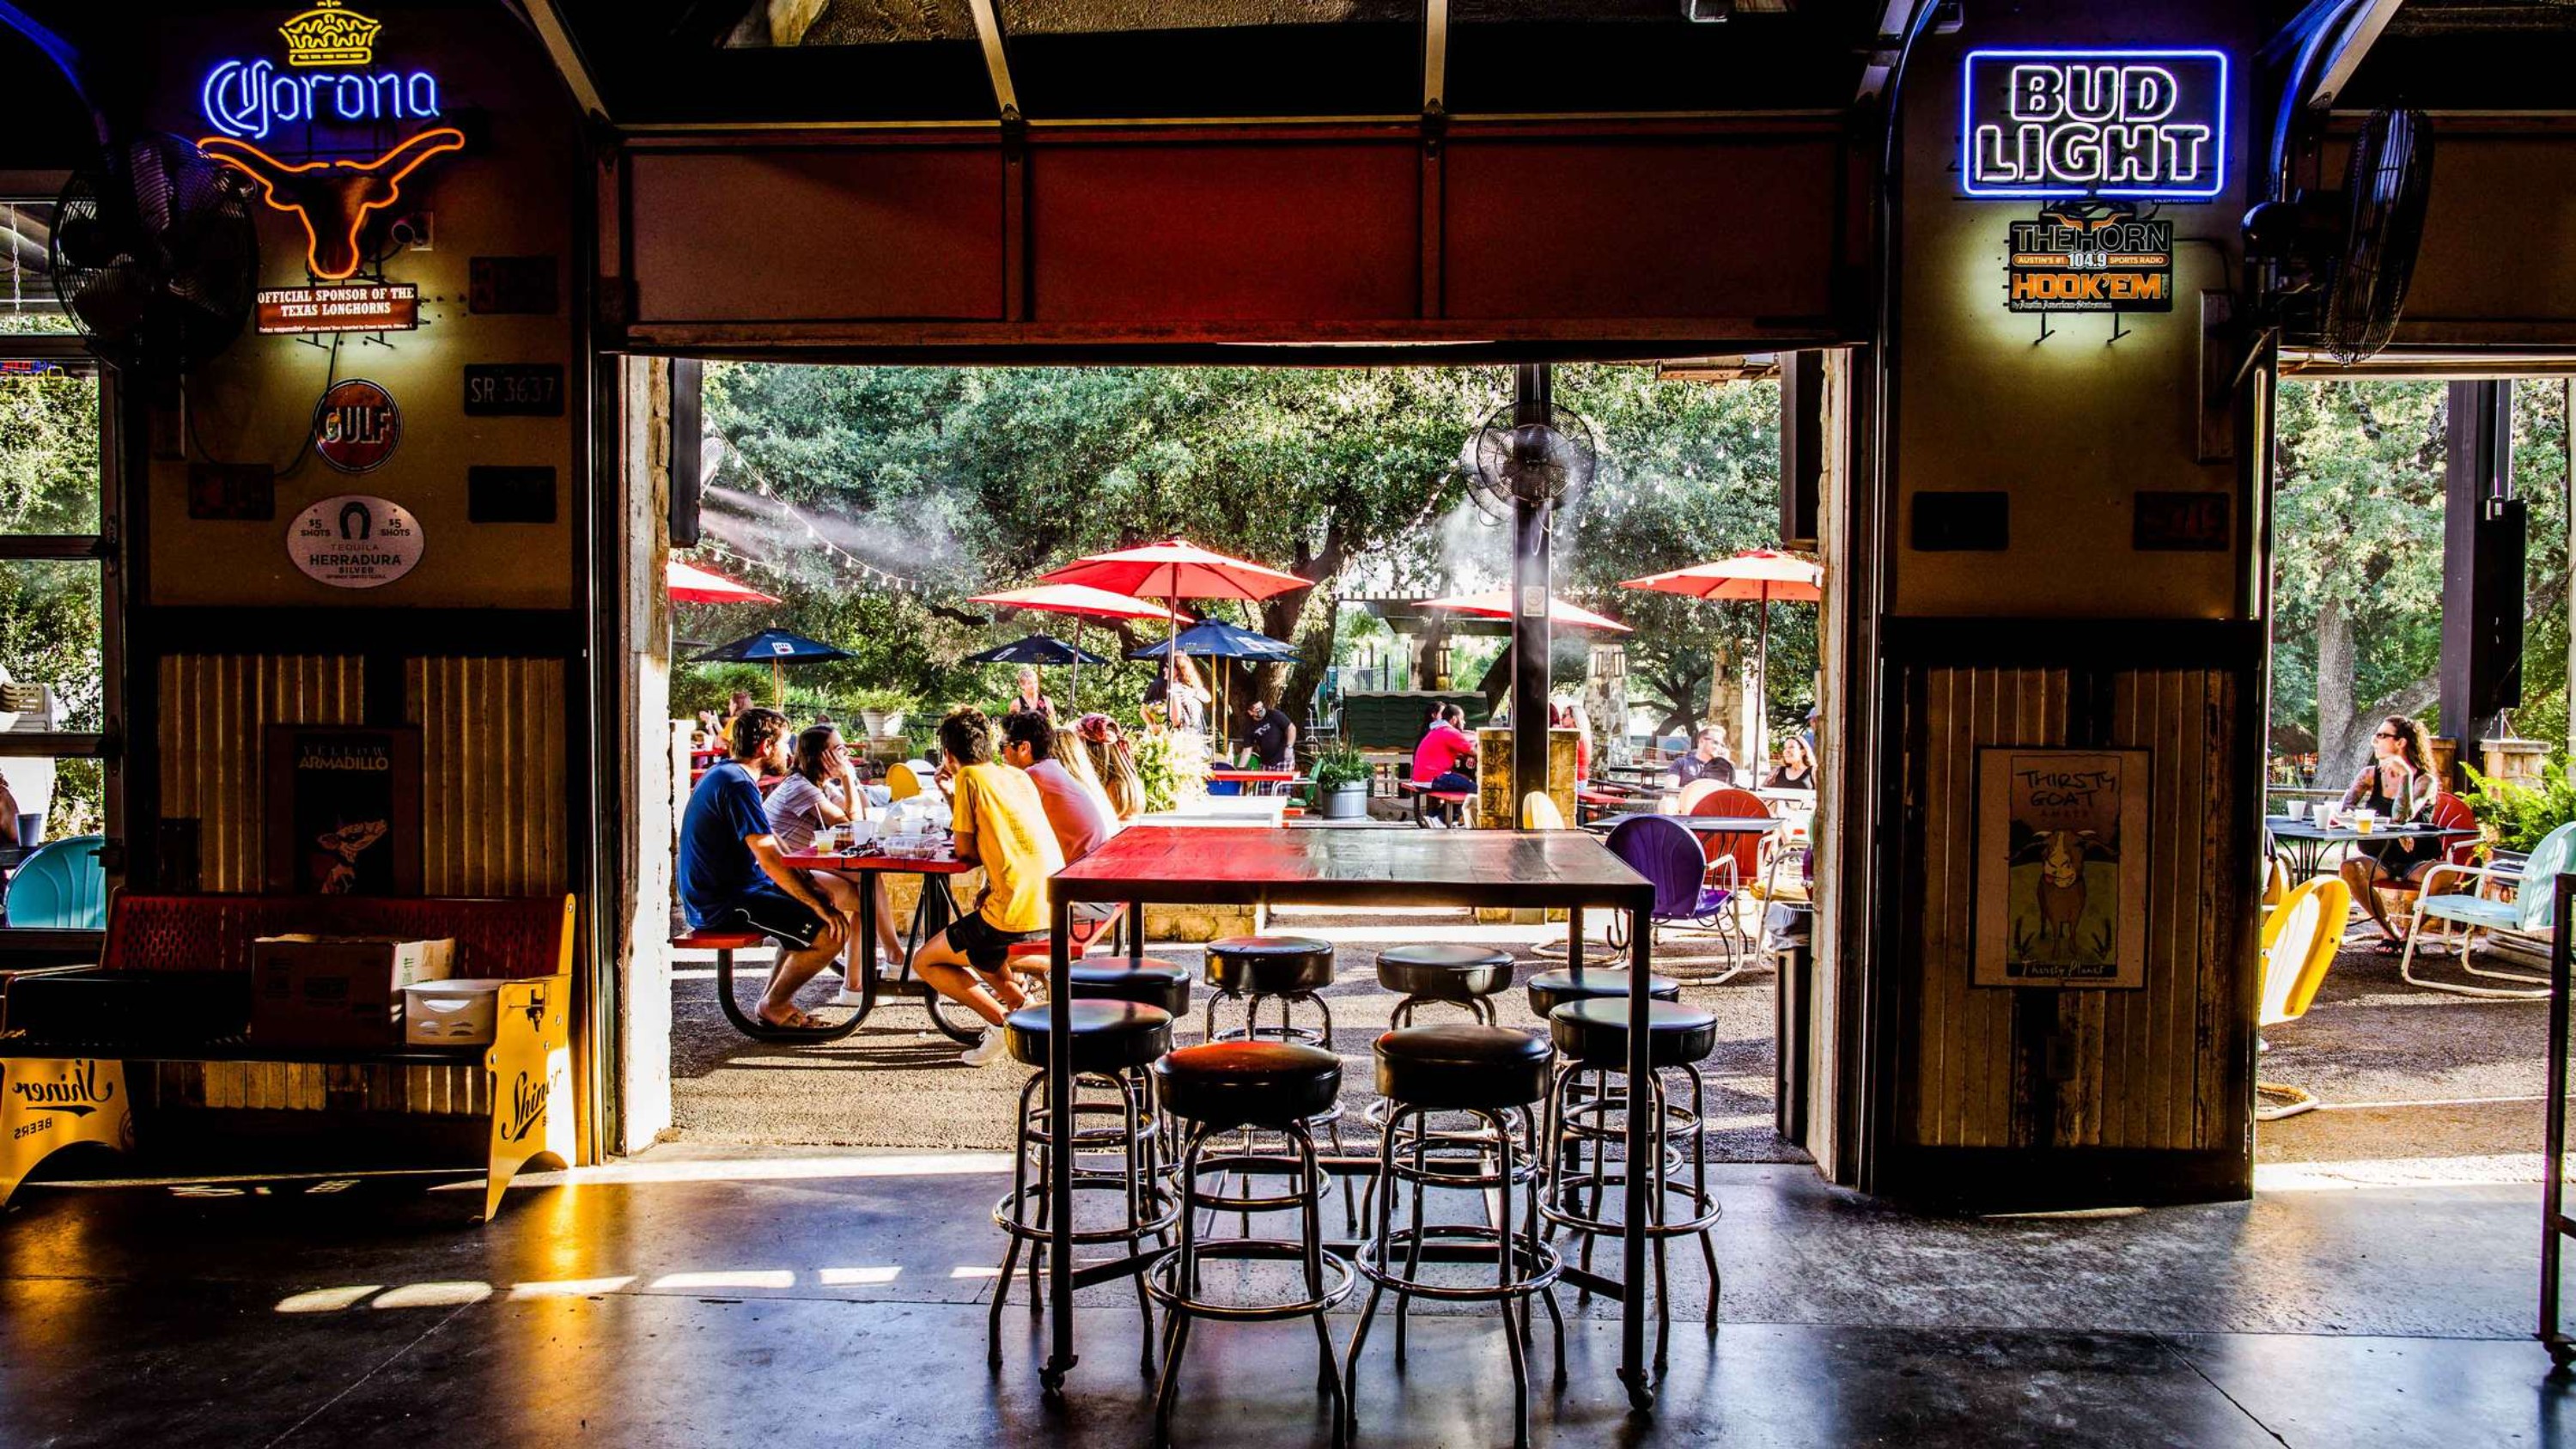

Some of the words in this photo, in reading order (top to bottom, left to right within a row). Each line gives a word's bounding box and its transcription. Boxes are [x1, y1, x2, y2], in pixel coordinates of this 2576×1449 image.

[204, 60, 440, 138] Corona
[2010, 64, 2177, 122] BUD
[1976, 123, 2210, 182] LIGHT
[2067, 252, 2107, 268] 104.9
[2110, 255, 2138, 264] SPORTS
[2139, 255, 2164, 264] RADIO
[2012, 273, 2161, 300] HOOK'EM
[258, 290, 312, 303] OFFICIAL
[316, 289, 368, 301] SPONSOR
[372, 289, 387, 300] OF
[390, 288, 414, 299] THE
[281, 304, 318, 317] TEXAS
[322, 302, 391, 315] LONGHORNS
[322, 405, 391, 444] GULF
[308, 519, 322, 529] $5
[389, 518, 401, 528] $5
[310, 554, 401, 566] HERRADURA
[297, 756, 389, 770] ARMADILLO
[2016, 770, 2115, 792] THIRSTY
[2031, 790, 2098, 807] GOAT
